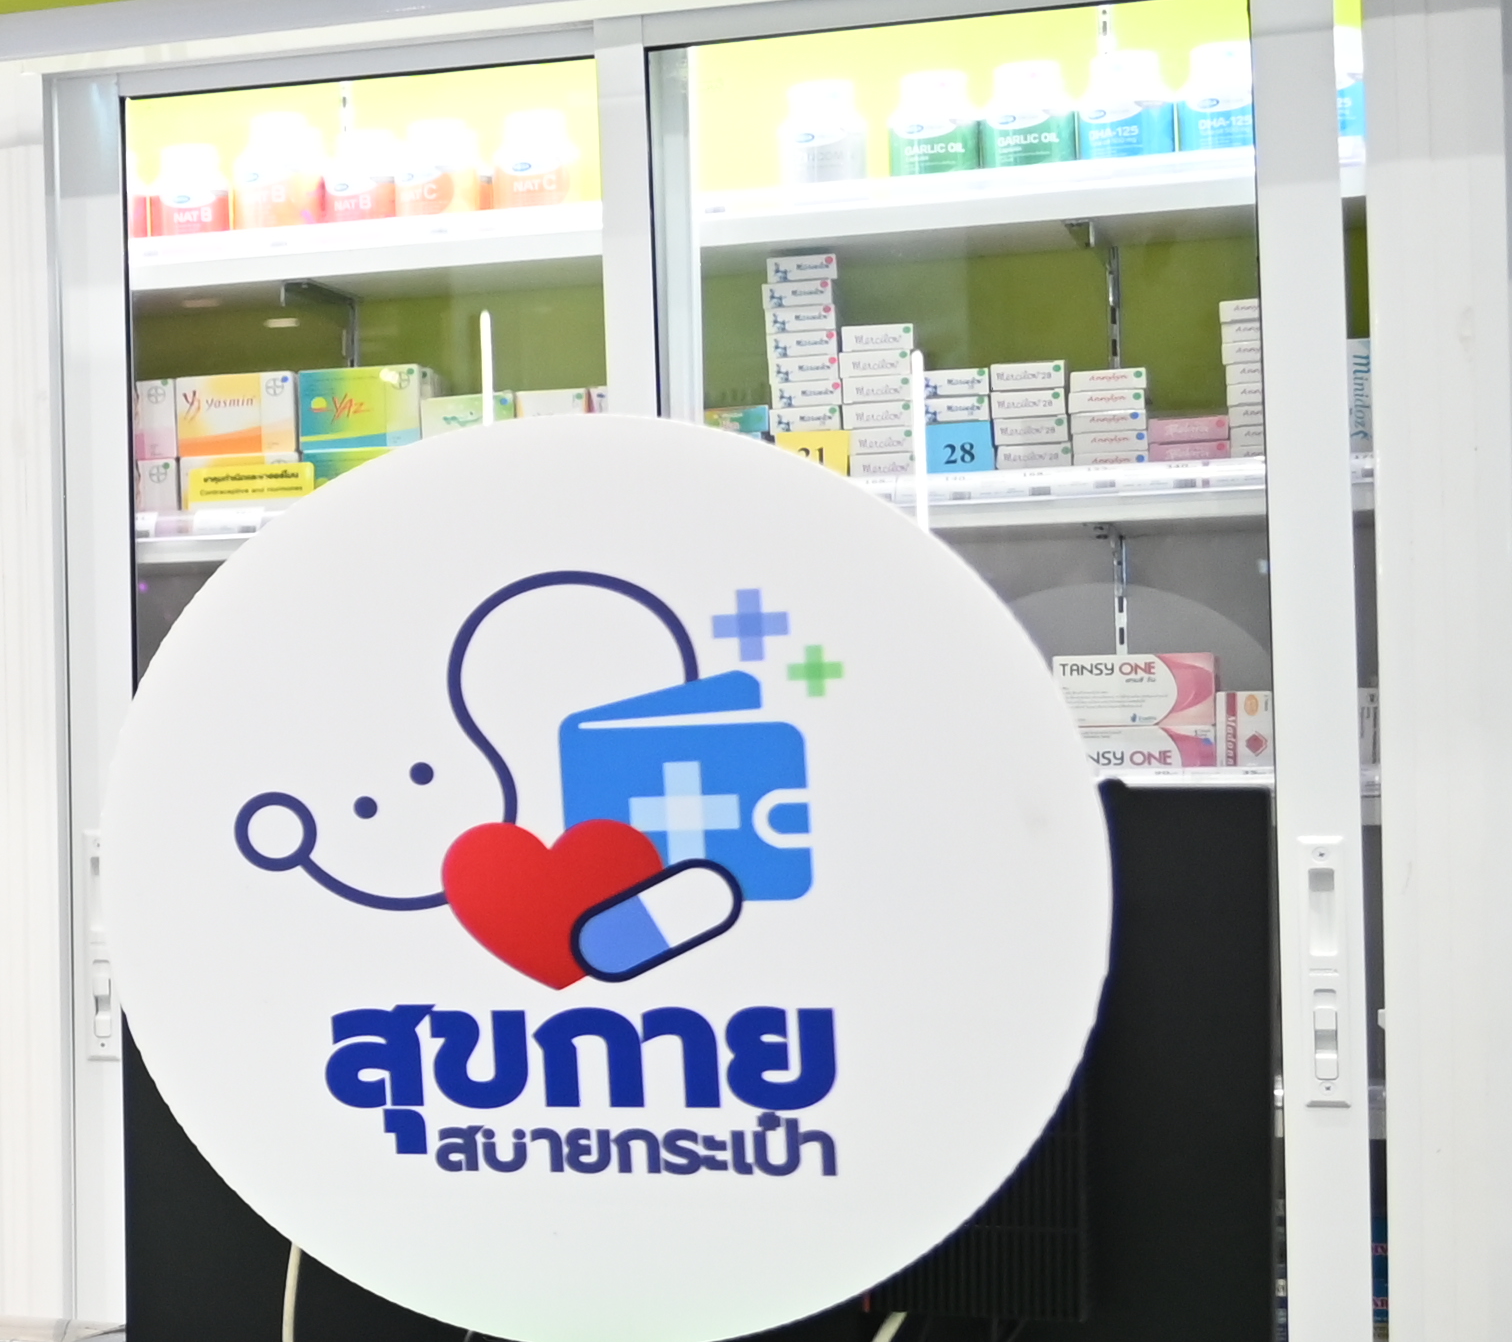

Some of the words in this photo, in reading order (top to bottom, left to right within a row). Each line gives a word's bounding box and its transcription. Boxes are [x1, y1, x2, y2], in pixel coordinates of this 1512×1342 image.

[903, 141, 948, 157] GARLIC
[512, 178, 542, 194] NAT
[173, 208, 201, 225] NAT
[200, 205, 213, 223] B
[942, 441, 976, 466] 28
[1059, 661, 1116, 677] TANSY
[1118, 660, 1157, 676] ONE
[323, 1003, 839, 1156] สุขกาย
[434, 1108, 840, 1177] สบายกระเป๋า
